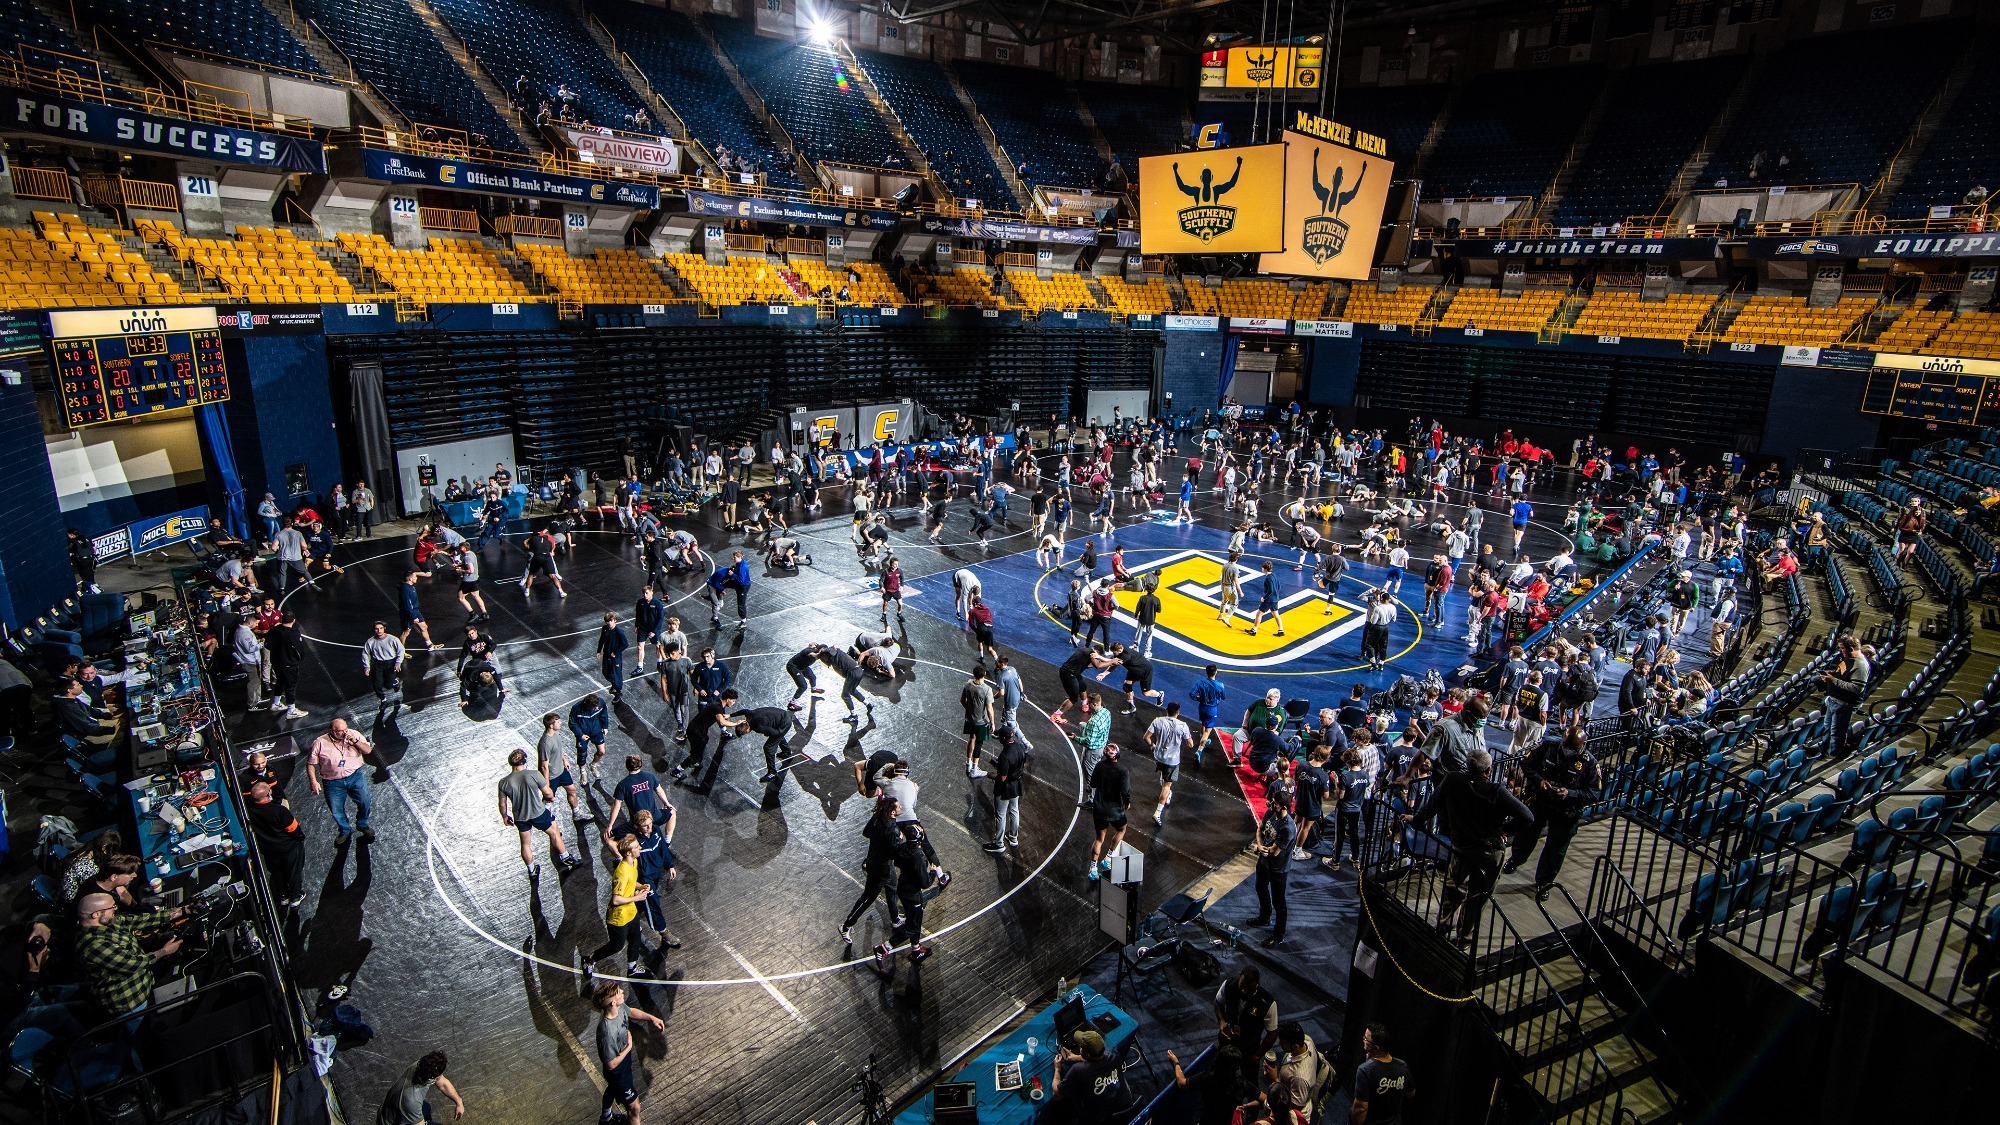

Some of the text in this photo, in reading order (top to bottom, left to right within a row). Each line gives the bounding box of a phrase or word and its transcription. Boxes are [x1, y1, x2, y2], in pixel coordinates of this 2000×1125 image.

[886, 27, 897, 38] 318
[997, 48, 1007, 58] 319
[17, 98, 277, 160] FOR SUCCESS
[1297, 110, 1386, 156] McKENZIE ARENA
[1198, 123, 1221, 149] C
[583, 140, 667, 163] PLAINVIEW
[187, 176, 211, 195] 211
[384, 164, 426, 179] FirstBank
[440, 165, 457, 183] C
[466, 171, 509, 188] Official
[512, 177, 540, 191] Bank
[544, 181, 584, 196] Partner
[590, 184, 604, 200] C
[393, 197, 416, 213] 212
[705, 200, 895, 226] erlanger C Exclusive Healthcare Provider C erlanger
[1181, 208, 1234, 221] SOUTHERN
[568, 213, 585, 227] 213
[1185, 218, 1230, 230] SCUFFLE
[707, 226, 722, 238] 214
[1306, 221, 1347, 240] SOUTHERN
[828, 236, 842, 246] 215
[1306, 233, 1342, 250] SCUFFLE
[1493, 241, 1664, 254] #JointheTeam
[1780, 240, 1837, 254] MOCS C CLUB
[1874, 237, 2000, 254] EQUIPPI
[938, 244, 950, 252] 216
[1040, 250, 1051, 258] 217
[1130, 255, 1140, 264] 218
[1508, 264, 1522, 274] 221
[1650, 266, 1668, 276] 222
[1818, 267, 1842, 279] 223
[1970, 267, 1996, 280] 224
[353, 305, 373, 314] 112
[497, 305, 514, 314] 113
[772, 306, 785, 314] 114
[120, 312, 167, 332] unum
[217, 315, 270, 326] FOOD CITY
[1184, 318, 1212, 326] choices
[1296, 322, 1313, 330] HHM
[129, 336, 165, 354] 44:33
[215, 338, 220, 348] 2
[64, 350, 94, 361] 4 0 0
[201, 354, 206, 362] 2
[103, 358, 132, 369] SOUTHERN
[1922, 359, 1964, 372] unum
[76, 367, 83, 376] 0
[91, 366, 98, 375] 0
[113, 362, 192, 388] 20 1 22
[65, 380, 100, 394] 23 1 8
[201, 378, 210, 388] 20
[68, 394, 103, 408] 25 0 0
[116, 384, 195, 410] 0 4 4 0
[71, 408, 106, 424] 35 1 5
[114, 410, 128, 418] SCORE
[873, 409, 900, 442] C
[420, 456, 427, 466] 8
[1666, 494, 1671, 502] 3
[143, 516, 203, 544] MOCS C CLUB
[94, 530, 127, 547] HATTAN
[1510, 596, 1521, 610] 2
[1122, 856, 1130, 882] 1
[1094, 1068, 1120, 1095] Staff
[1376, 1076, 1406, 1094] Staff
